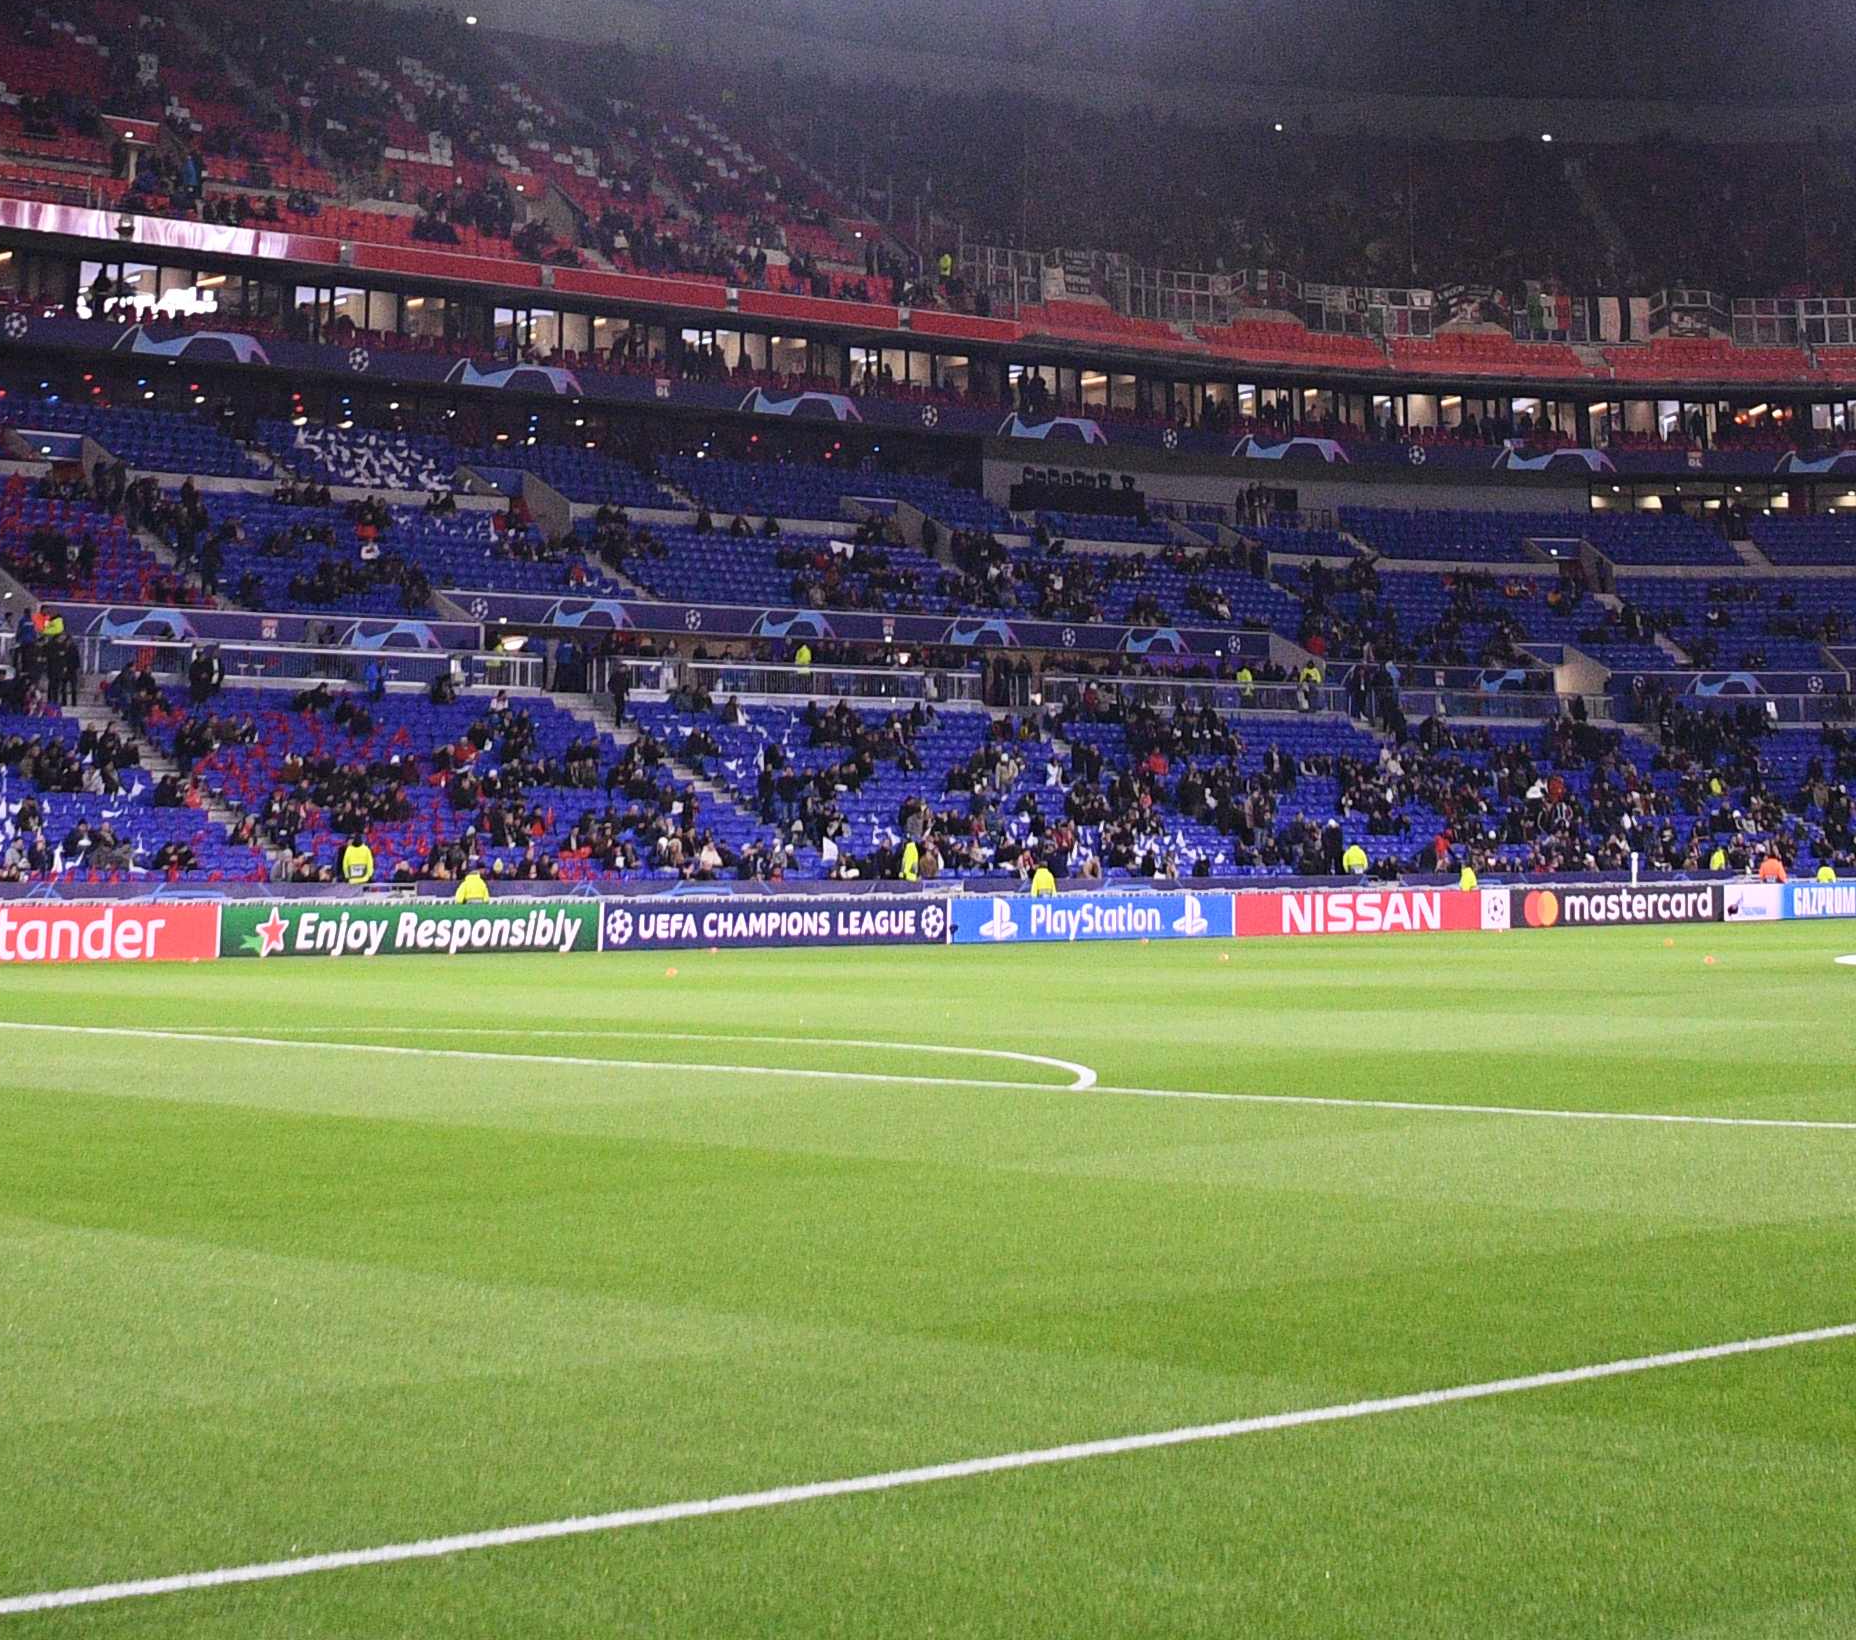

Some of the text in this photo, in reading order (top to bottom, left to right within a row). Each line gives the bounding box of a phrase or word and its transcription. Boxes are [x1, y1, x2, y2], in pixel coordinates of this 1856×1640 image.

[1281, 891, 1442, 934] NISSAN
[1564, 888, 1713, 922] mastercard
[1793, 886, 1856, 916] GAZPROM
[295, 909, 582, 956] Enjoy Responsibly
[638, 909, 916, 939] UEFA CHAMPIONS LEAGUE
[1030, 902, 1161, 941] PlayStation
